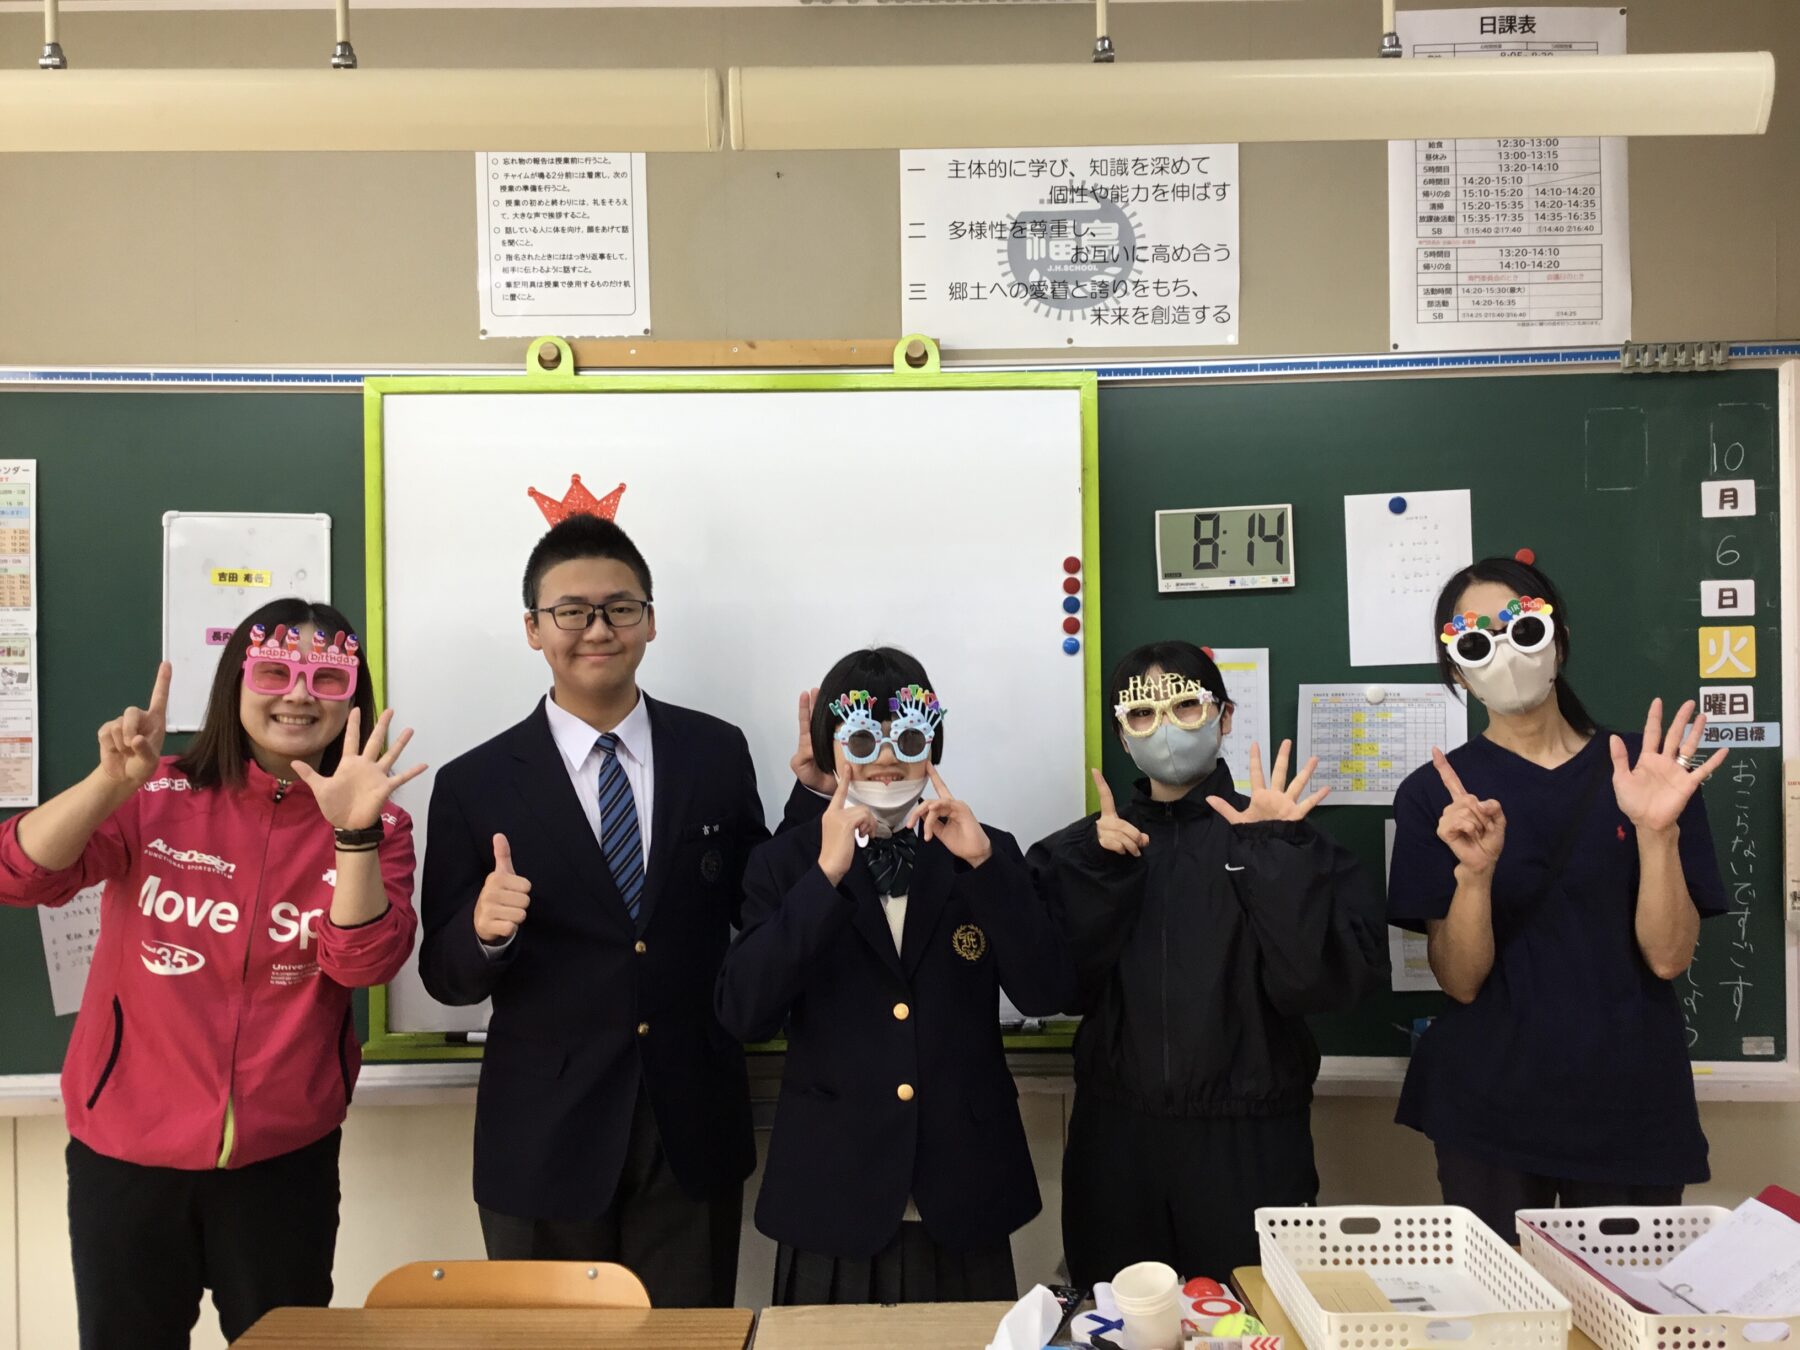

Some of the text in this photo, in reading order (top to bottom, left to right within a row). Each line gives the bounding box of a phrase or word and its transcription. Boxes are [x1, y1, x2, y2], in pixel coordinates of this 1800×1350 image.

[1480, 15, 1537, 35] 日課表
[1428, 141, 1443, 149] 給食
[1497, 139, 1559, 147] 12:30-13:00
[1425, 153, 1447, 161] 昼休み
[1498, 151, 1559, 160] 13:00-13:15
[1423, 165, 1450, 173] 5時間目
[1498, 163, 1559, 172] 13:20-14:10
[1423, 177, 1450, 185] 6時間目
[1462, 176, 1523, 185] 14:20-15:10
[1049, 181, 1232, 204] 個性や能力を伸ばす
[1422, 190, 1451, 198] 帰りの会
[1463, 189, 1524, 197] 15:10-15:20
[1535, 187, 1595, 196] 14:10-14:20
[1462, 201, 1524, 210] 15:20-15:35
[1534, 200, 1596, 208] 14:20-14:35
[1462, 214, 1524, 222] 15:35-17:35
[1534, 212, 1596, 221] 14:35-16:35
[948, 219, 1097, 241] 多様性を尊重し、
[501, 239, 534, 247] を聞くこと。
[1070, 243, 1232, 264] お互いに高め合う
[1423, 250, 1451, 258] 5時間目
[1499, 248, 1560, 256] 13:20-14:10
[1423, 262, 1451, 270] 帰りの会
[1499, 261, 1560, 269] 14:10-14:20
[948, 279, 1199, 301] 郷土への愛着と誇りをもち、
[1423, 287, 1452, 295] 活動時間
[1472, 299, 1516, 307] 14:20-16:35
[1089, 304, 1232, 326] 未来を創造する
[1713, 441, 1744, 472] 10
[0, 466, 30, 475] ンダー
[1719, 487, 1739, 511] 月
[1193, 511, 1285, 571] 8:14
[1716, 534, 1740, 566] 6
[1718, 587, 1738, 609] 日
[1705, 630, 1751, 674] 火
[1703, 692, 1750, 716] 曜日
[268, 901, 325, 951] Sp
[155, 947, 189, 968] 35
